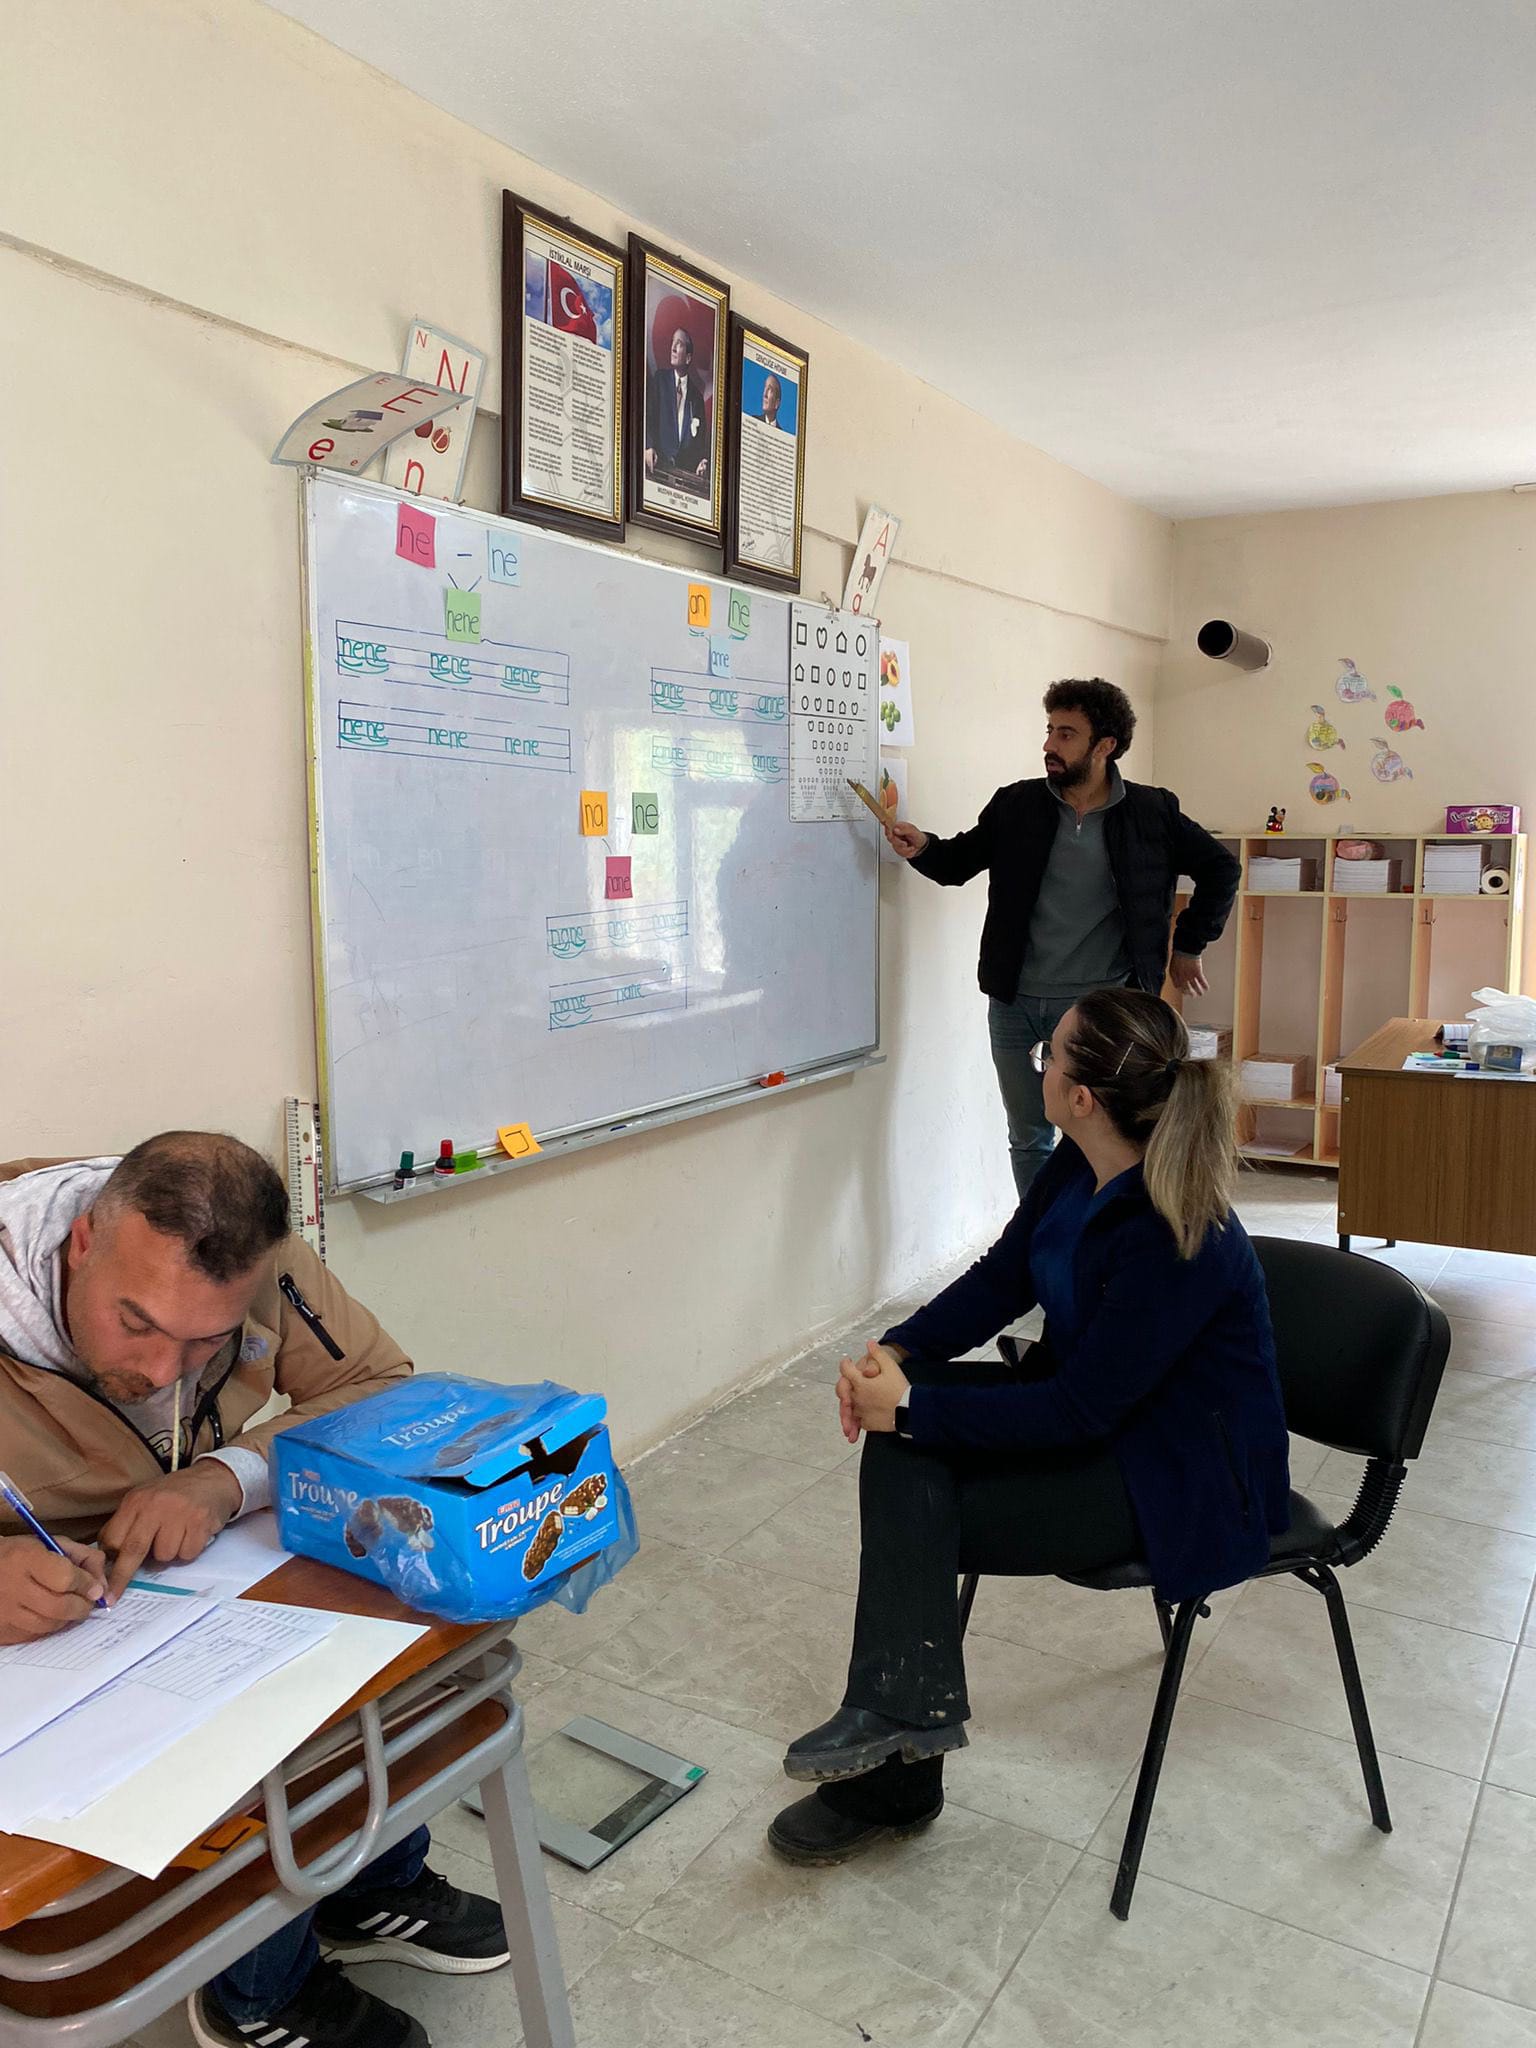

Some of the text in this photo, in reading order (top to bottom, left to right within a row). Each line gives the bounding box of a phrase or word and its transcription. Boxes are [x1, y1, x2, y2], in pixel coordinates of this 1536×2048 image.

[416, 330, 427, 348] N
[436, 349, 469, 394] N
[381, 387, 438, 414] E
[308, 438, 335, 460] e
[405, 459, 425, 495] n
[400, 524, 431, 555] ne
[872, 522, 890, 557] A
[491, 548, 518, 576] ne
[446, 609, 480, 634] nene
[731, 600, 750, 628] ne
[340, 637, 539, 684] nene nene nene
[342, 718, 539, 756] nene nene nene
[584, 803, 604, 828] na
[634, 803, 659, 830] ne
[381, 1405, 468, 1446] Troupe
[474, 1482, 564, 1549] Troupe
